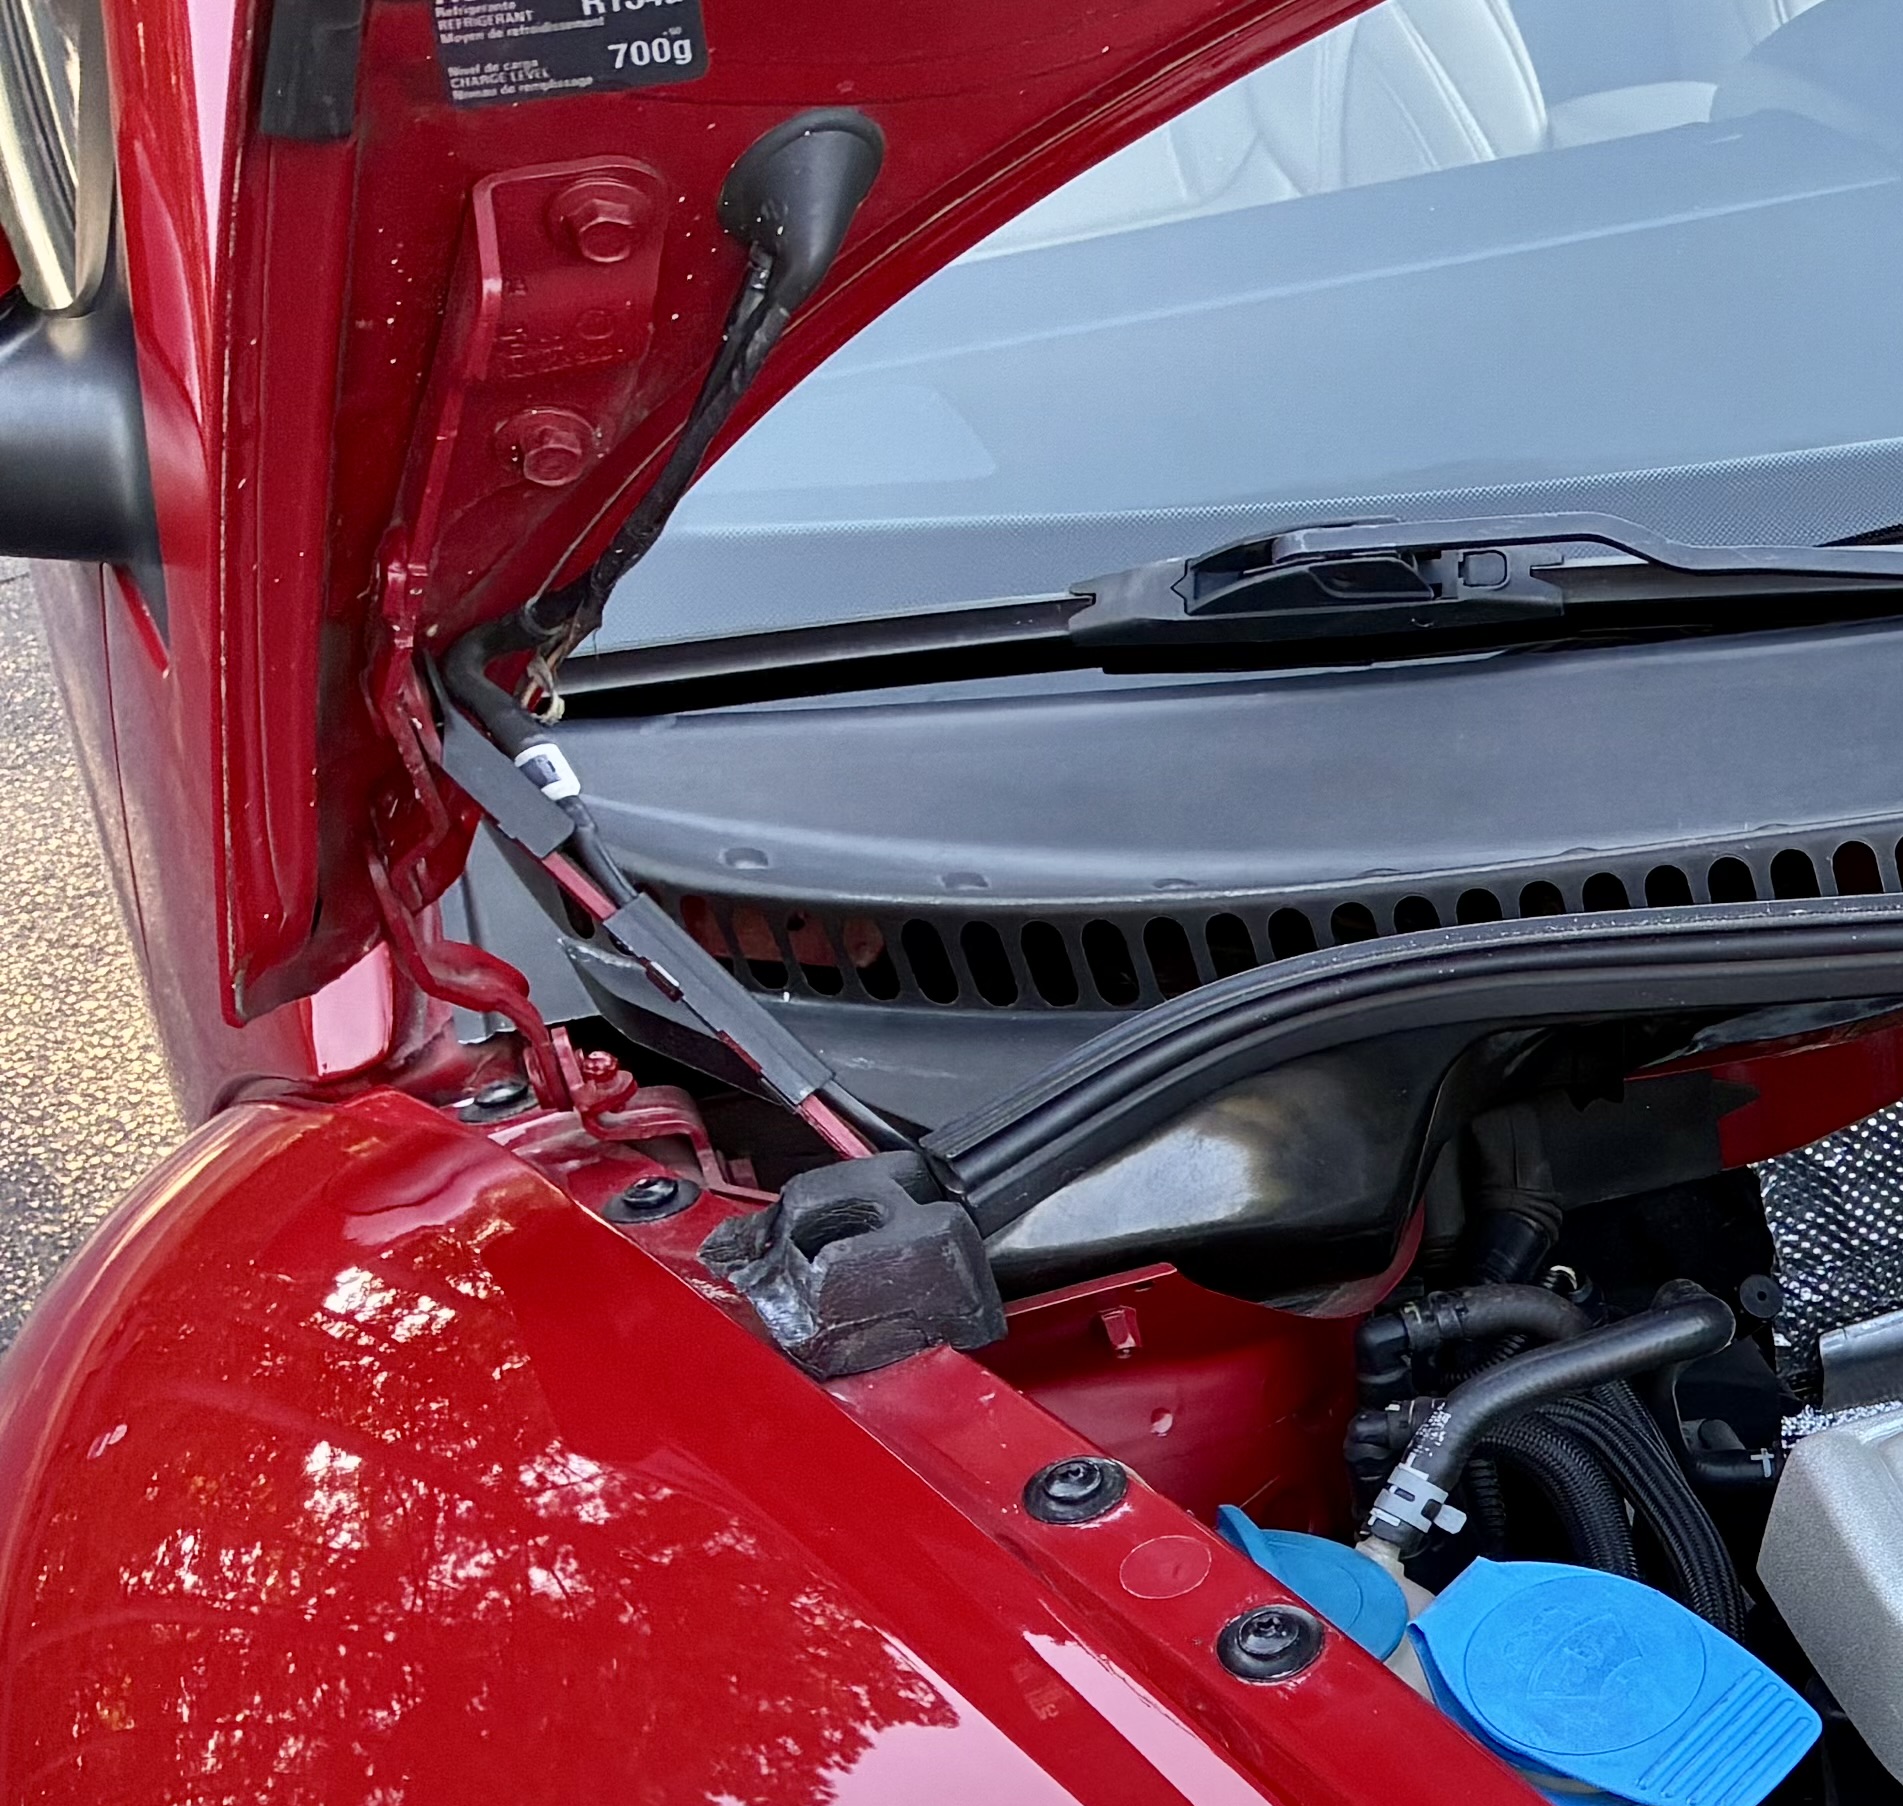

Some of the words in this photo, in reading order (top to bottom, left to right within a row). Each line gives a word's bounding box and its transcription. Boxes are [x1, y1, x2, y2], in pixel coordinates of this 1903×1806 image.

[438, 10, 534, 30] REFRIGERANT
[488, 29, 503, 39] de
[608, 38, 692, 69] 700g
[450, 72, 507, 88] CHARGE
[510, 68, 549, 82] LEVEL
